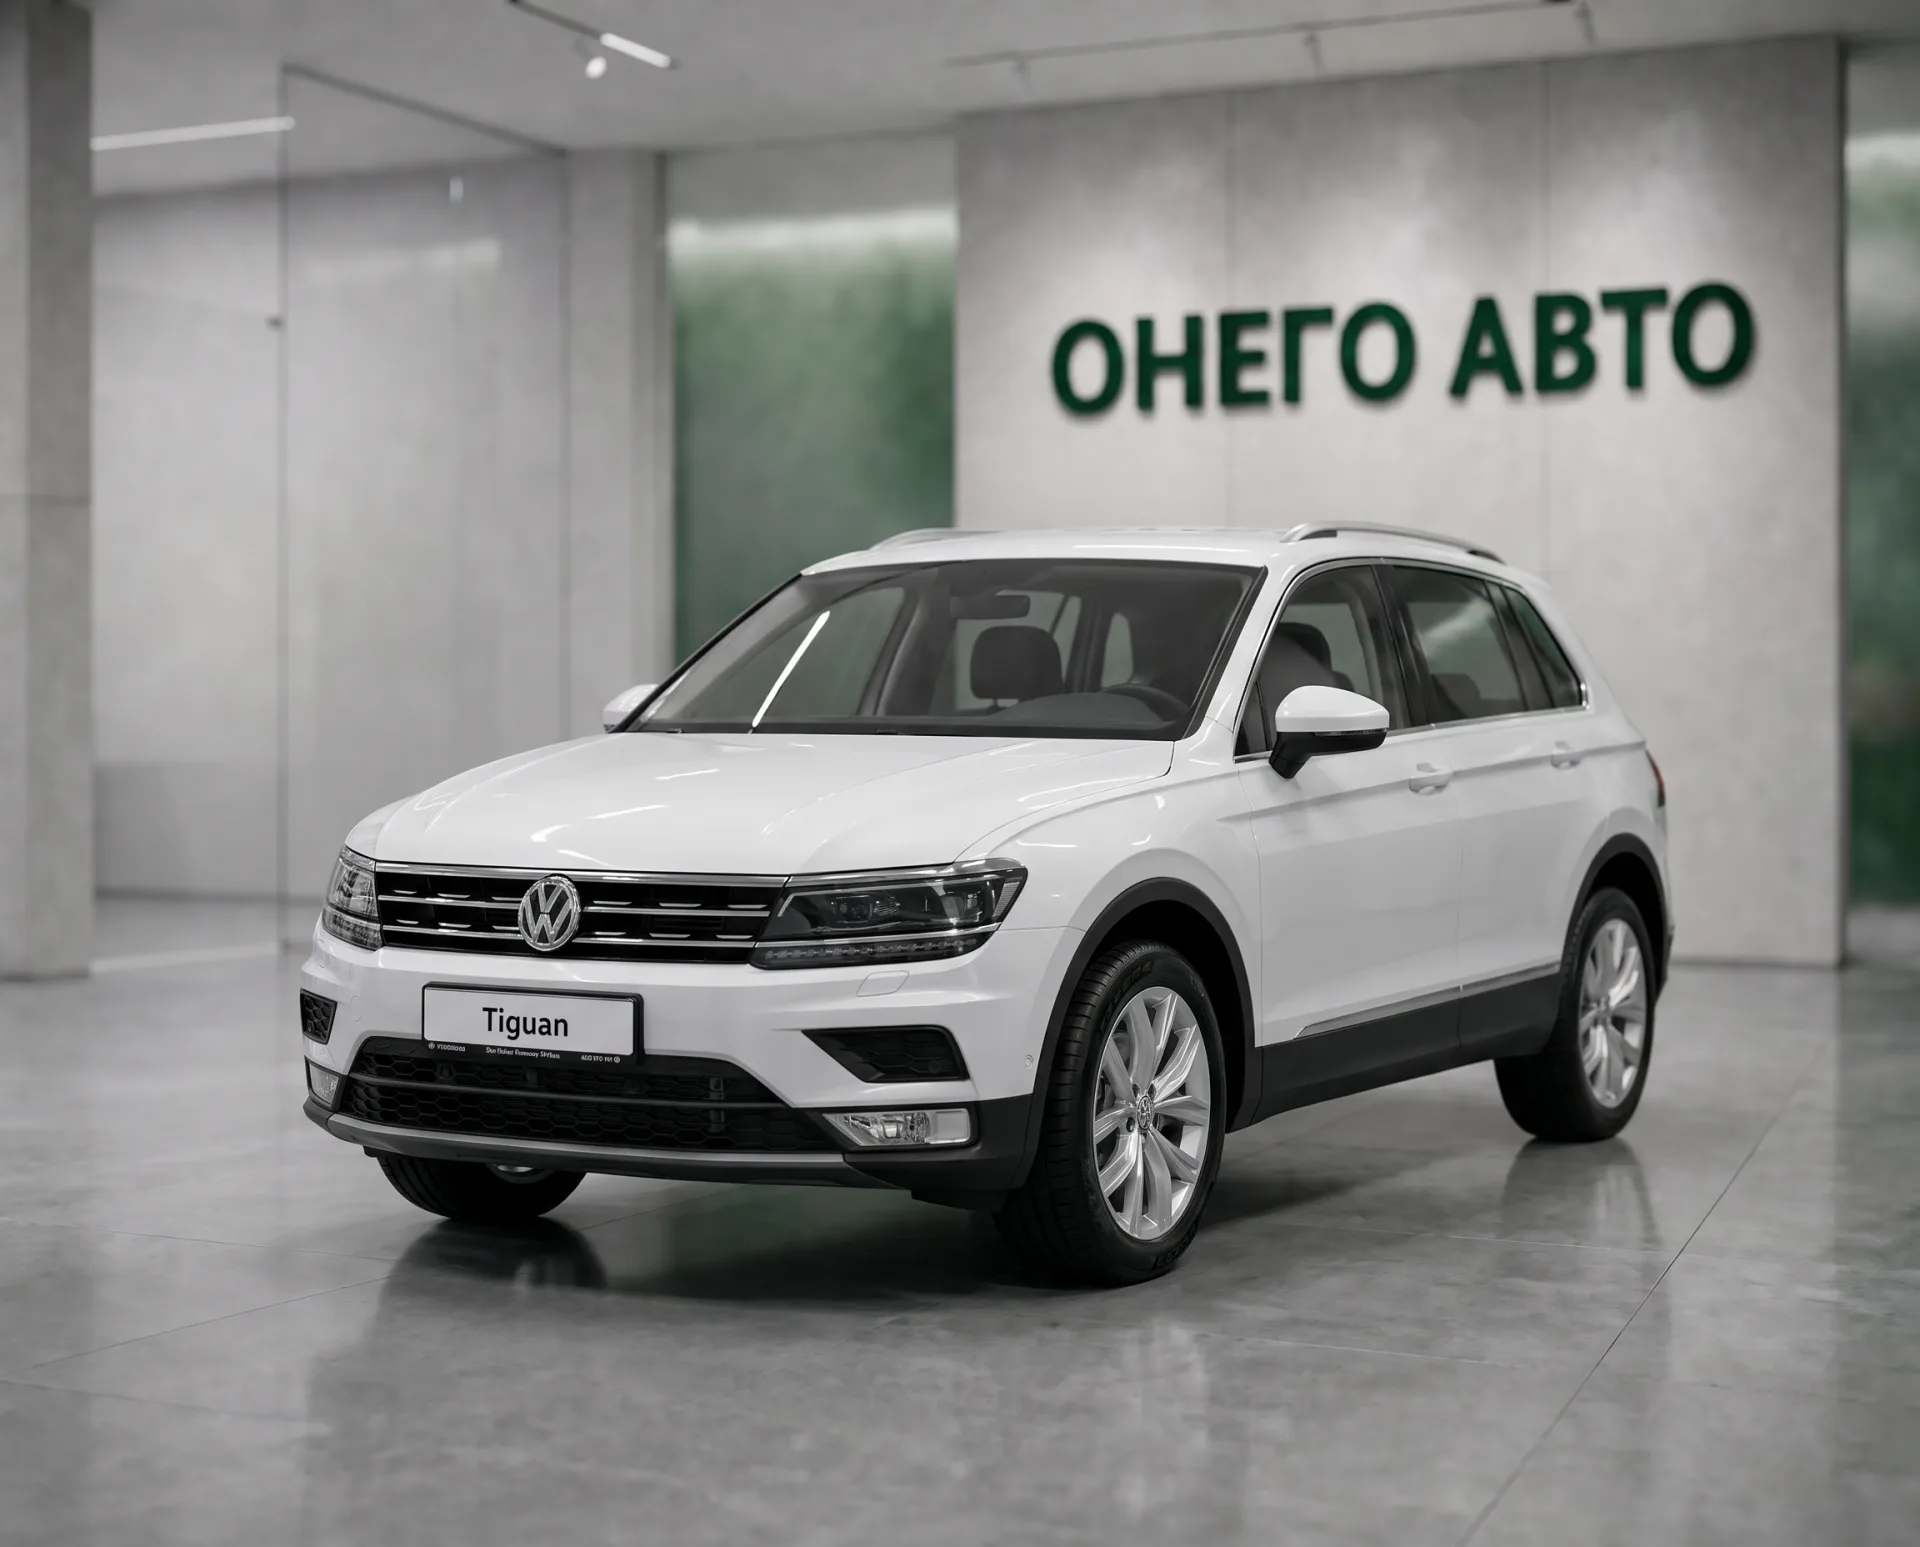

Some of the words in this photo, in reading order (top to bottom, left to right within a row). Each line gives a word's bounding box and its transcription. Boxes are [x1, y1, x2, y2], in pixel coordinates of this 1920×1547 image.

[1052, 302, 1416, 414] ОНЕГО
[1451, 283, 1753, 398] АВТО
[482, 1006, 569, 1041] Tiguan
